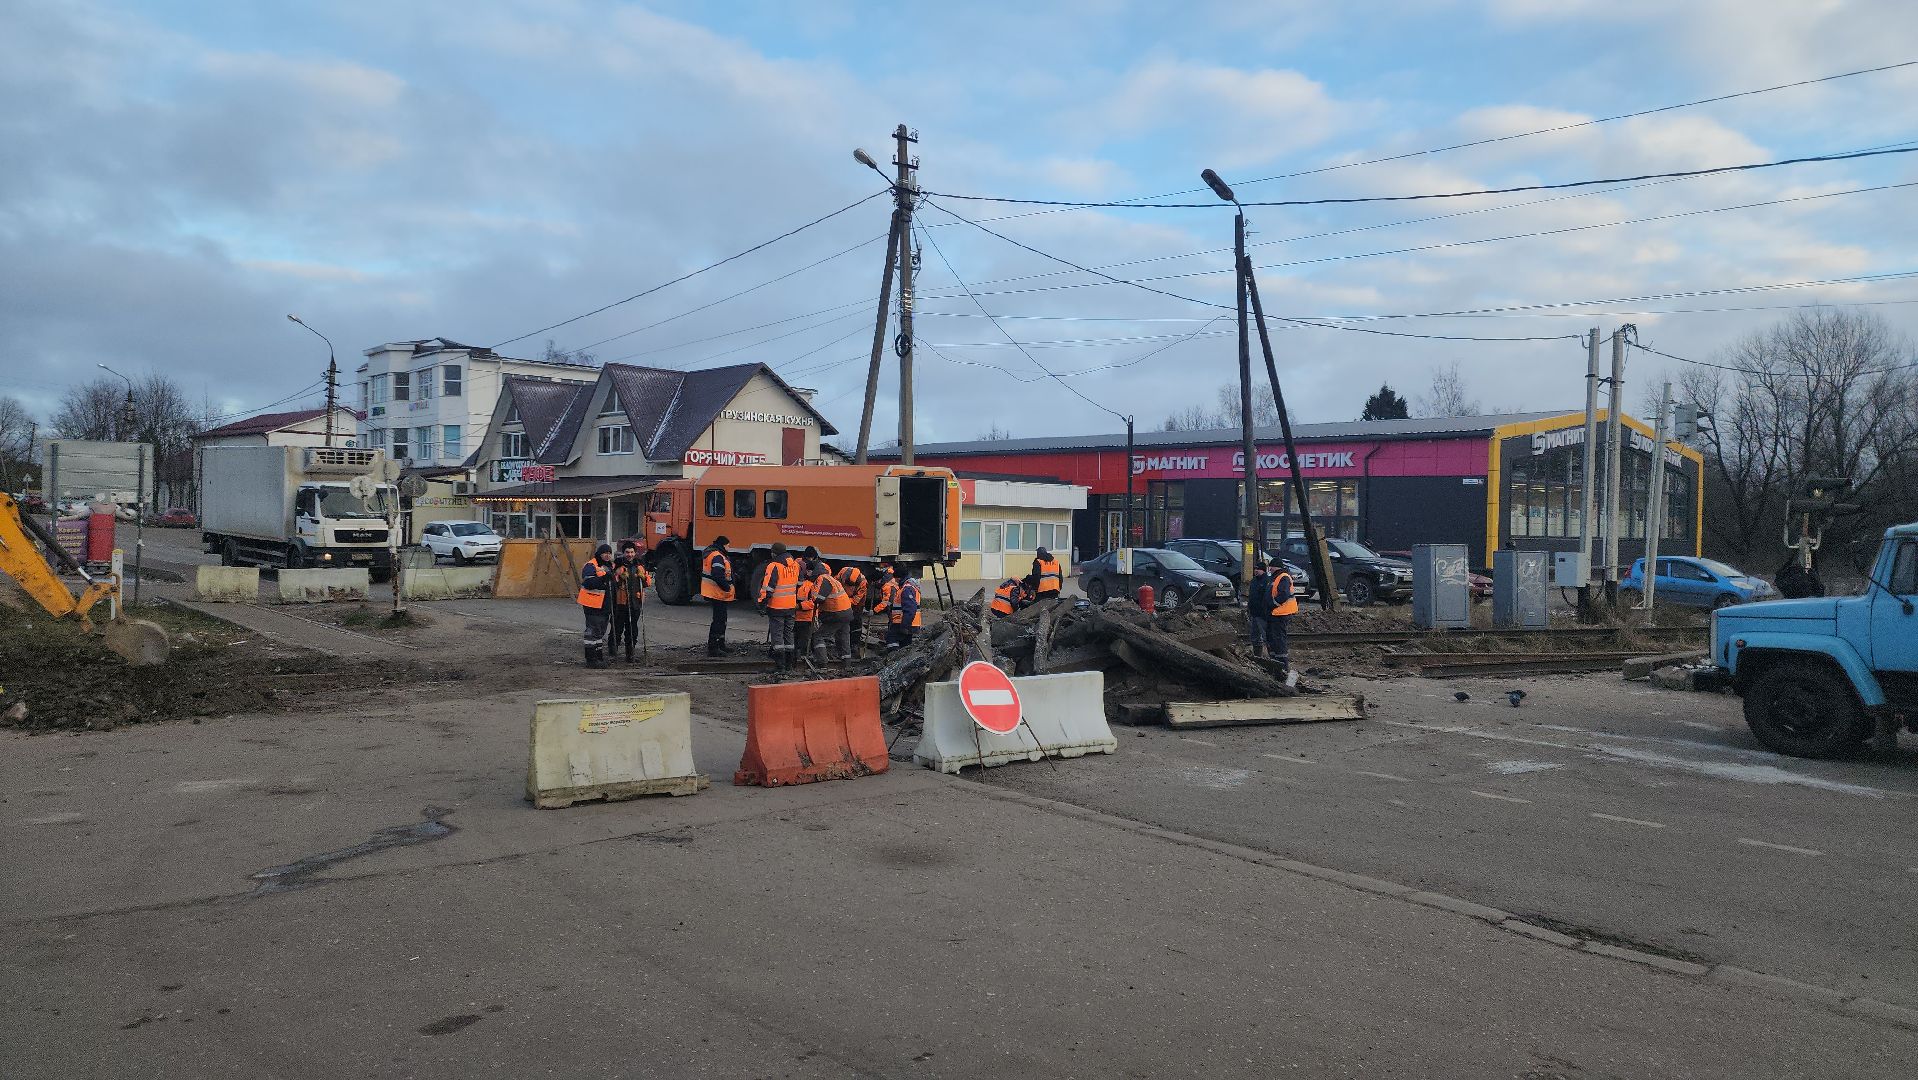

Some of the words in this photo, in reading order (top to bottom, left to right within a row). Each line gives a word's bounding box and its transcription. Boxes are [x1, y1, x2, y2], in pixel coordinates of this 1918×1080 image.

[721, 409, 781, 423] ГРУЗИНСКАЯ
[782, 415, 814, 427] КУХНЯ
[1547, 427, 1585, 450] МАГНИТ
[684, 450, 736, 466] ГОРЯЧИЙ
[738, 454, 767, 465] ХЛЕБ
[1147, 456, 1209, 470] МАГНИТ
